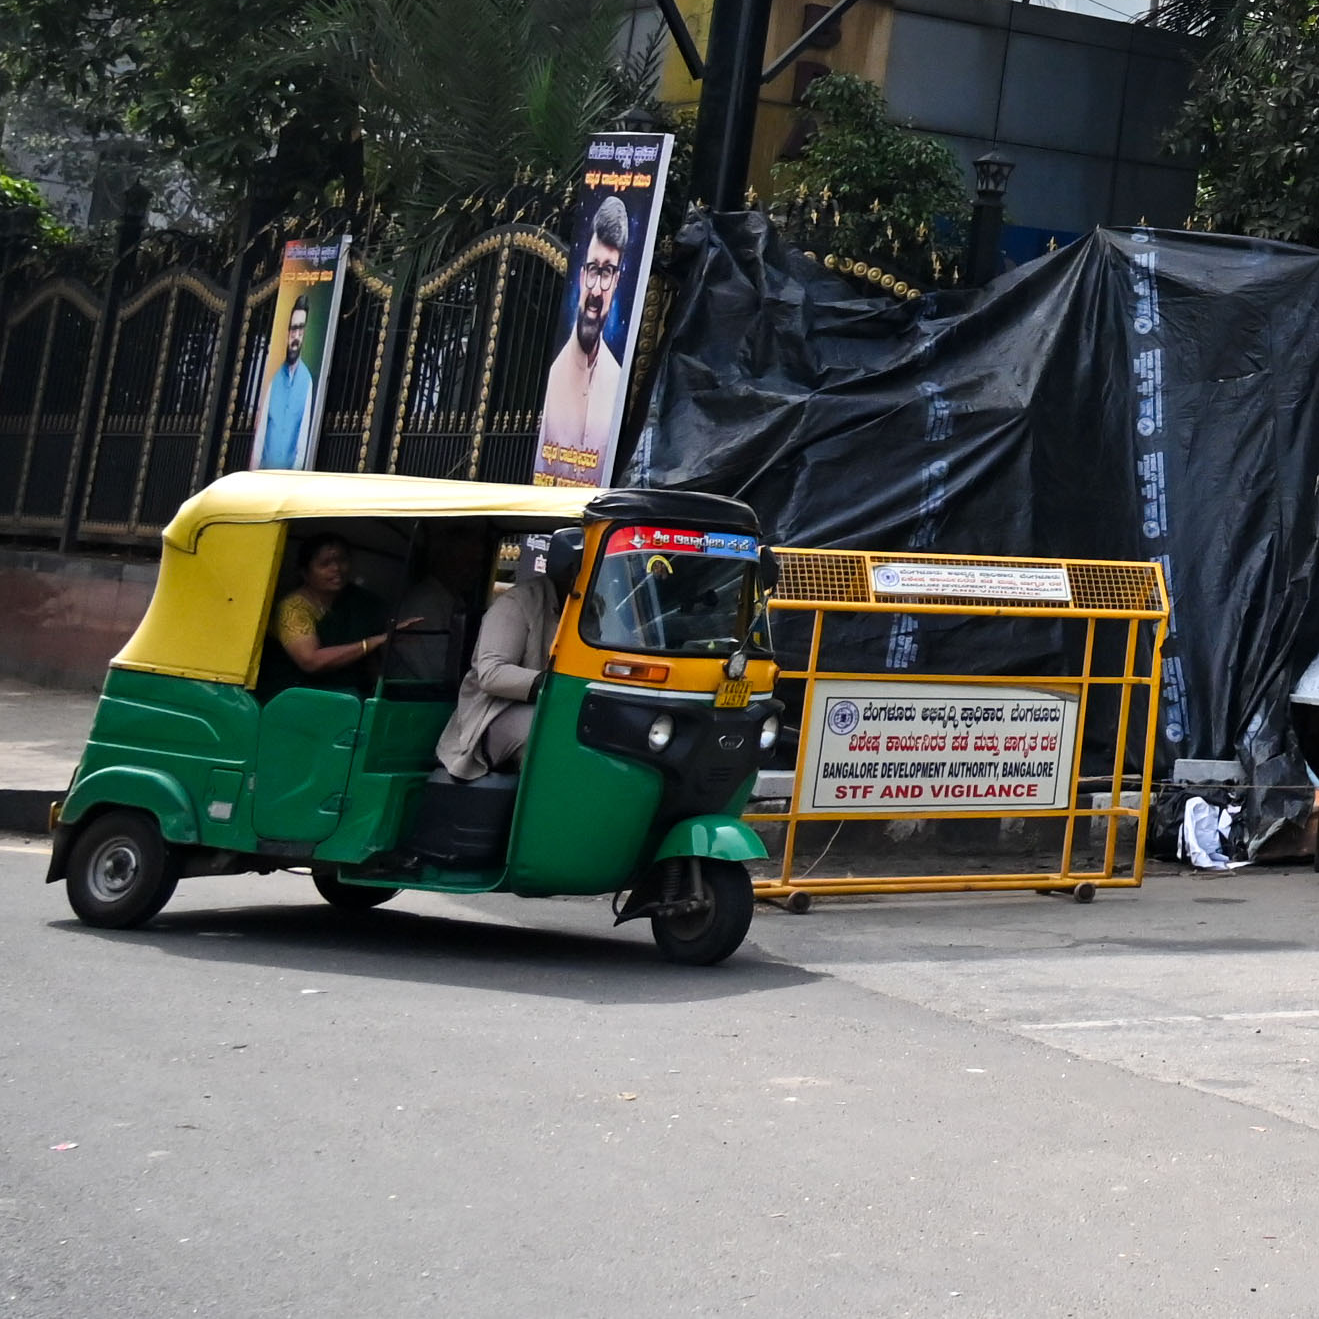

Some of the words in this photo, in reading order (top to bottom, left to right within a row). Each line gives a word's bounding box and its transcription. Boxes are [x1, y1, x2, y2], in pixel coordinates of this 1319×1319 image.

[823, 762, 879, 779] BANGALORE
[881, 762, 946, 779] DEVELOPMENT
[1002, 762, 1054, 777] BANGALORE
[835, 785, 874, 799] STF
[880, 785, 923, 798] AND
[931, 784, 1038, 798] VIGILANCE
